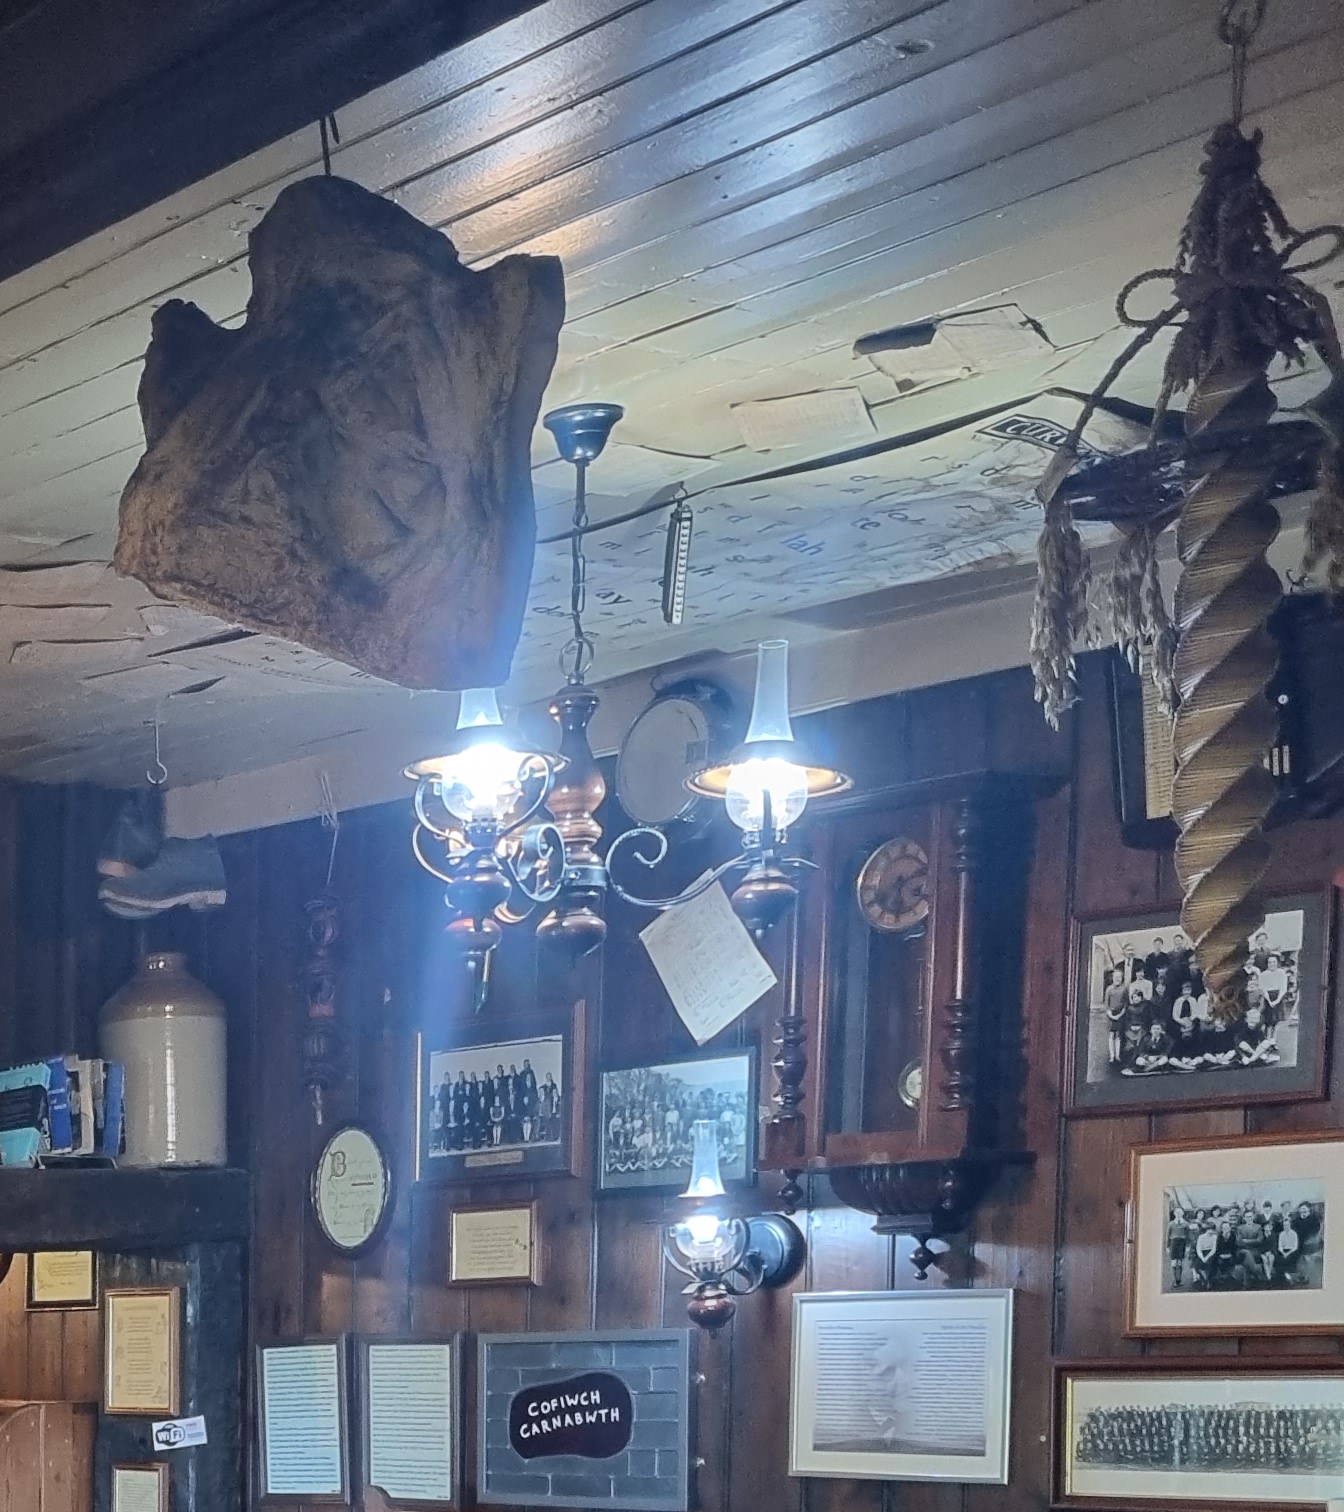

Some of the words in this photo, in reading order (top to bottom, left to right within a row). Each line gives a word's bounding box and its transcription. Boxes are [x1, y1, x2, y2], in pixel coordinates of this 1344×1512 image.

[779, 532, 827, 557] lah
[527, 1389, 601, 1417] COFIWCH
[519, 1407, 620, 1439] CARNABWTH
